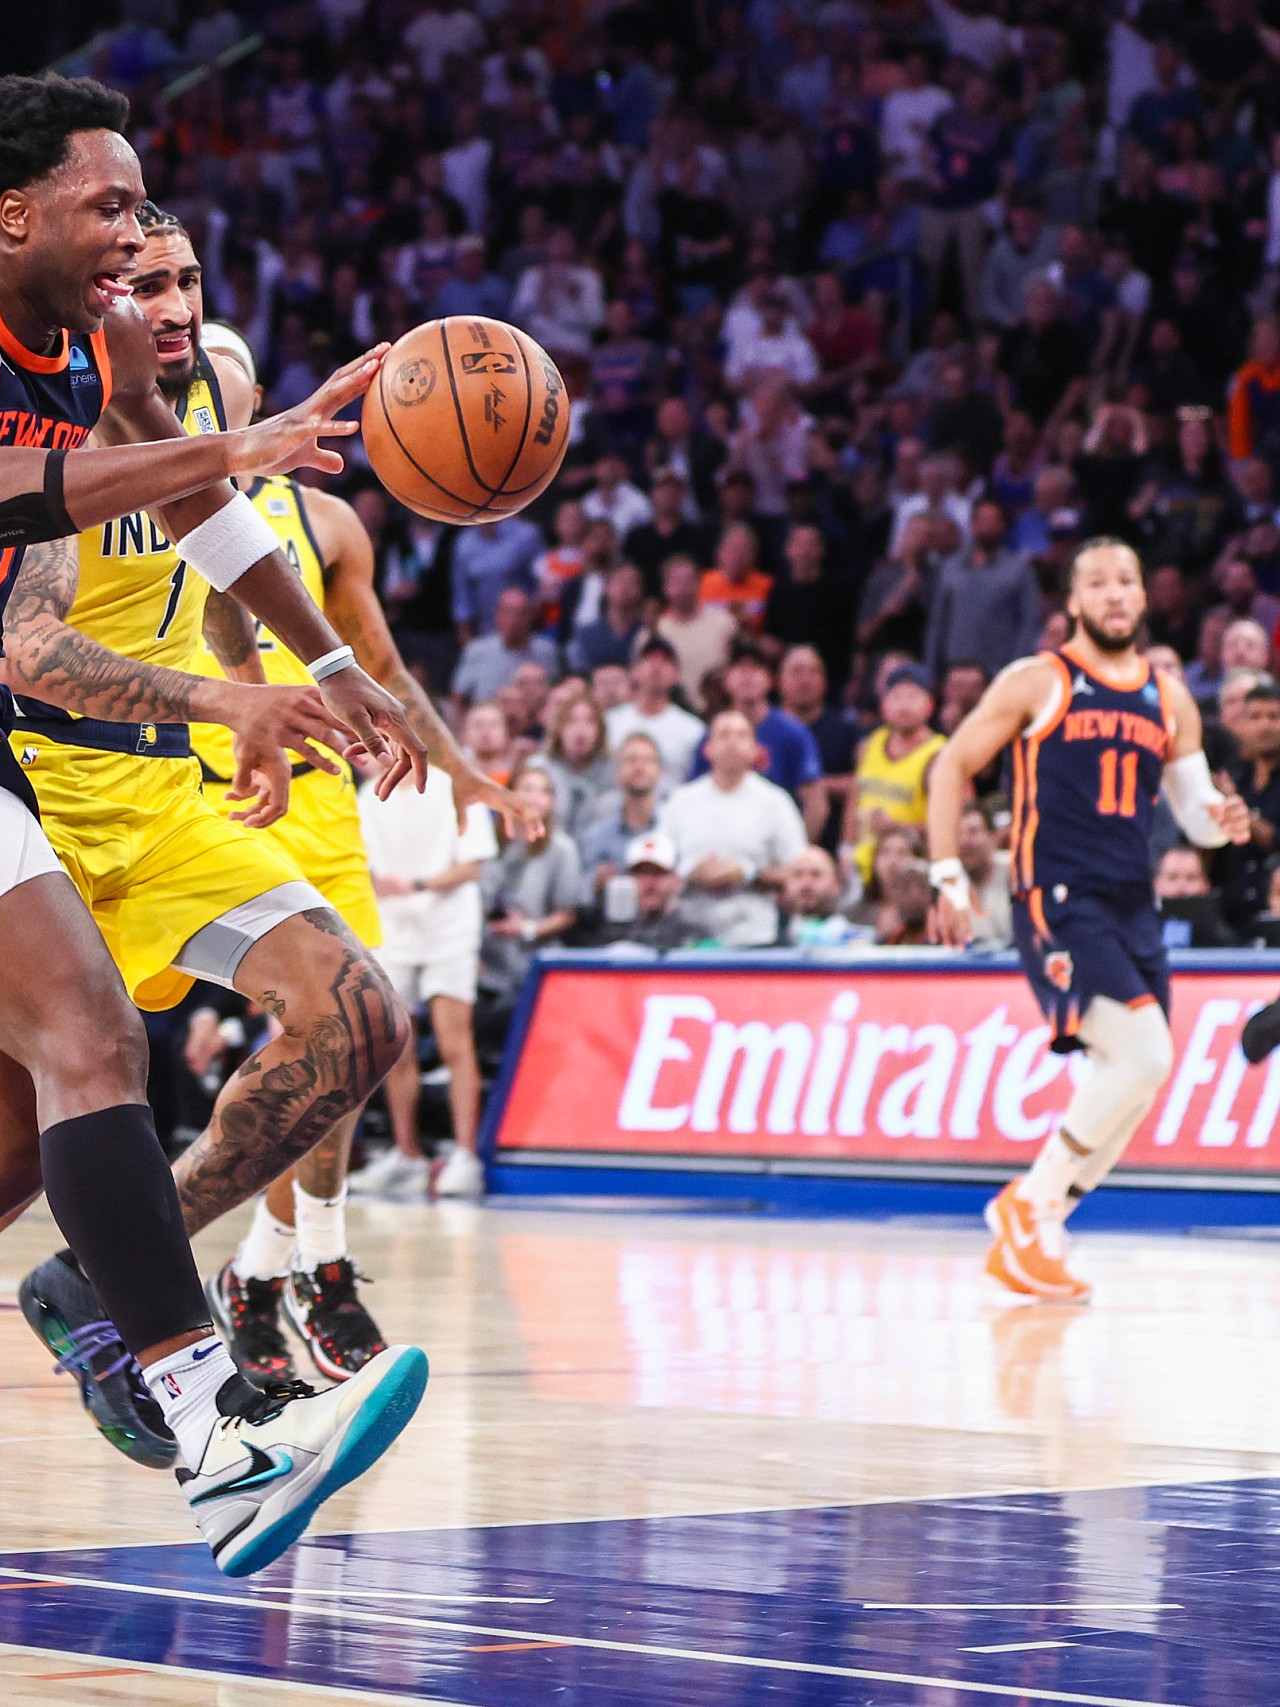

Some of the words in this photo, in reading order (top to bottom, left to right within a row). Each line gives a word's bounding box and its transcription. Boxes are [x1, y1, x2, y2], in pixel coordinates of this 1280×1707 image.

[154, 559, 187, 642] 1
[1063, 709, 1119, 742] NEW
[1121, 710, 1168, 759] YORK
[1096, 748, 1139, 817] 11
